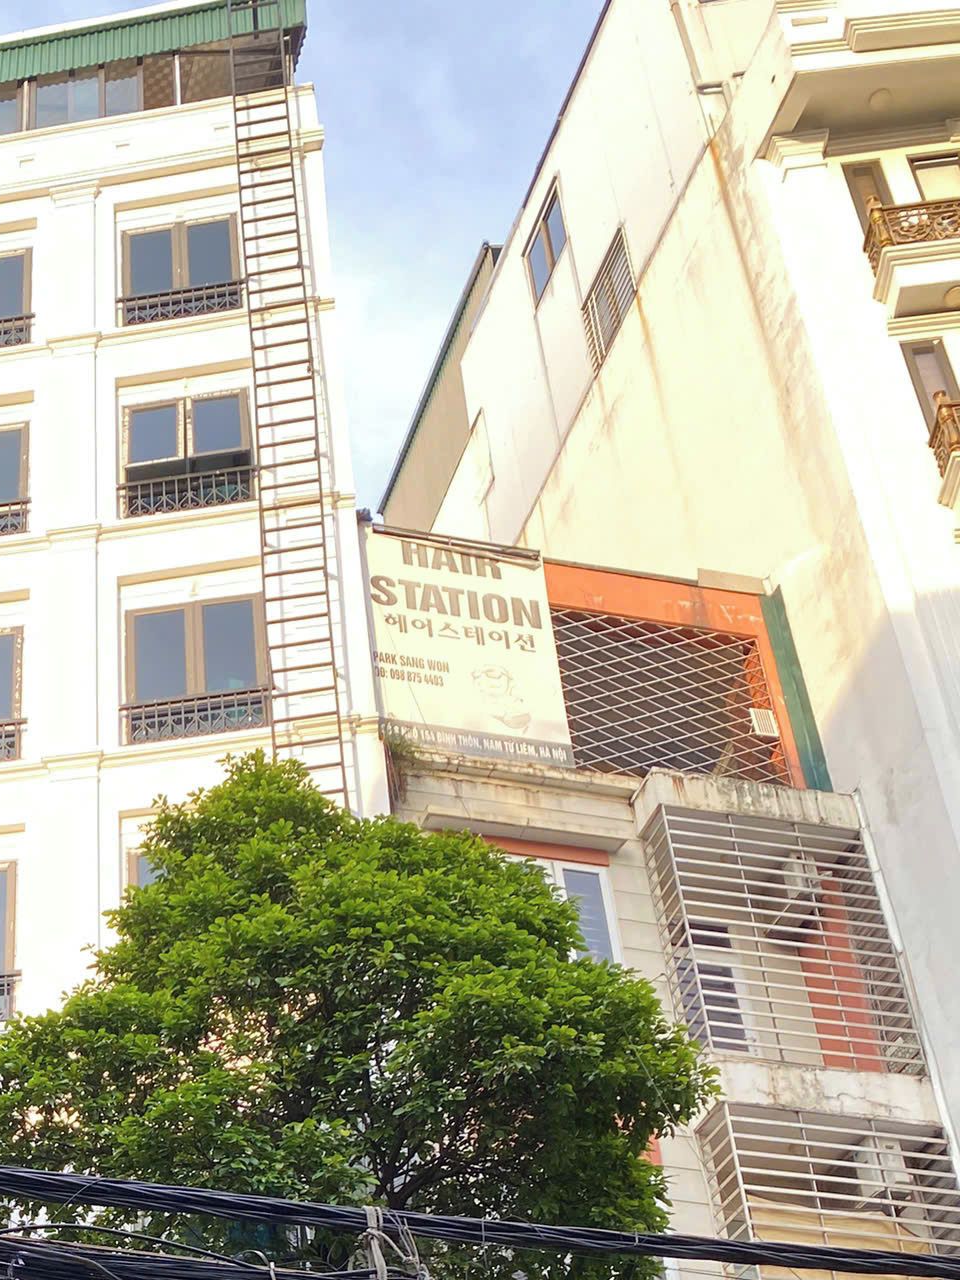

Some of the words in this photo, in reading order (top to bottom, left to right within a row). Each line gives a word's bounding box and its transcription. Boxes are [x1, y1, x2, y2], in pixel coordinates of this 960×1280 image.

[401, 540, 503, 579] HAIR
[370, 575, 543, 629] STATION
[384, 614, 537, 653] 헤어스테이션
[373, 651, 398, 665] PARK
[400, 655, 425, 669] SANG
[427, 659, 450, 673] WON
[390, 668, 405, 681] 098
[407, 671, 423, 683] 875
